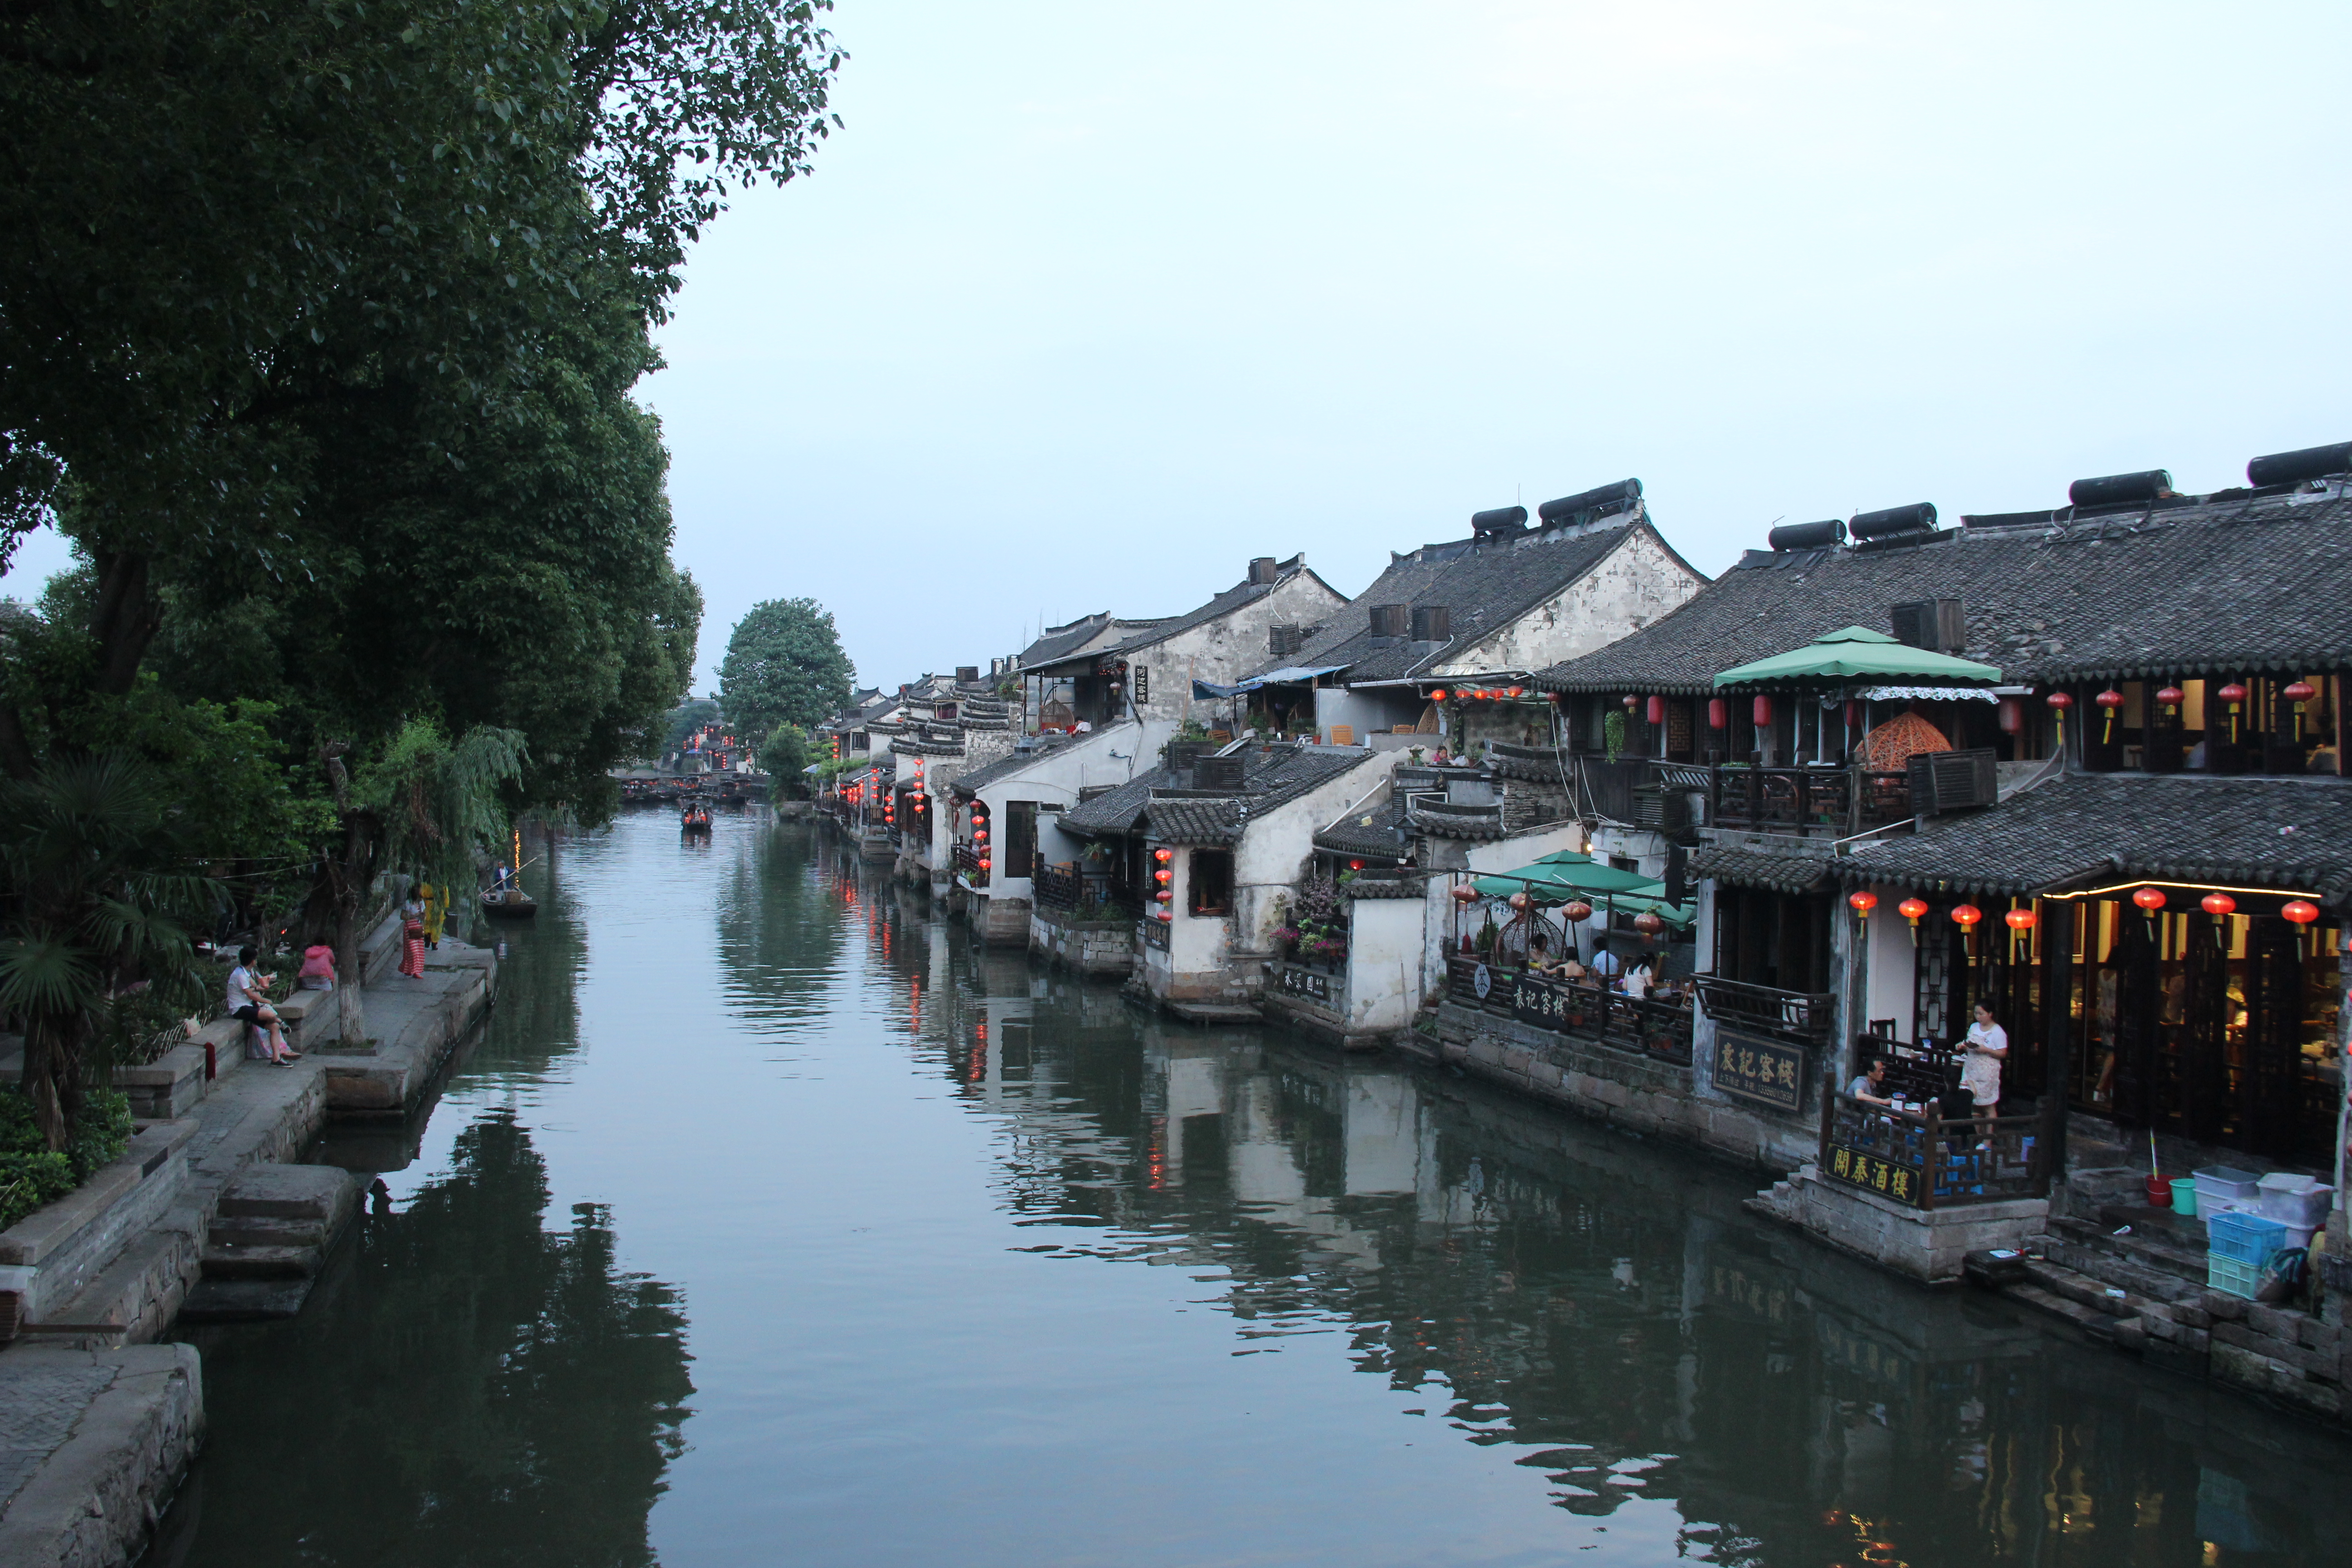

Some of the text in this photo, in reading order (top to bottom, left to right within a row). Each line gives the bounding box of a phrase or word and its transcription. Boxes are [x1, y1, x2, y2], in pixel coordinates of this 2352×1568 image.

[1137, 666, 1146, 702] 河边客栈
[1476, 969, 1489, 993] 茶
[1834, 1148, 1909, 1200] 開泰酒樓
